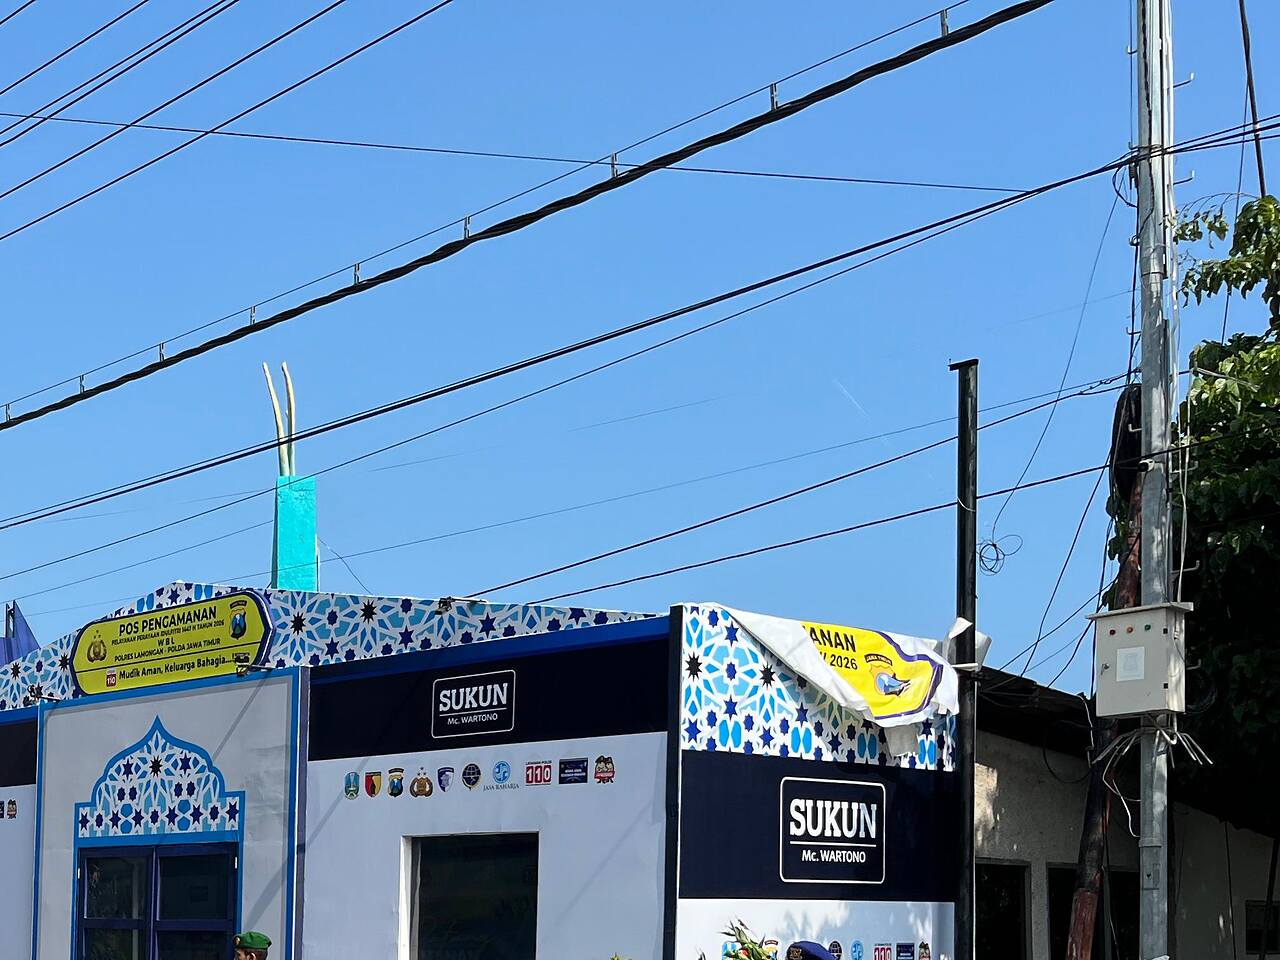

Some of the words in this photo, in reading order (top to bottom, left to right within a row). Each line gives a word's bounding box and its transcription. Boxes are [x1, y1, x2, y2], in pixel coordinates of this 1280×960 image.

[119, 618, 139, 636] POS
[141, 606, 217, 633] PENGAMANAN
[114, 652, 133, 662] POLRES
[133, 648, 163, 659] LAMONGAN
[167, 643, 186, 653] POLDA
[186, 641, 202, 650] JAWA
[202, 637, 221, 647] TIMUR
[119, 666, 140, 680] Mudik
[141, 664, 163, 677] Aman,
[164, 660, 196, 674] Keluarga
[830, 654, 858, 670] 2026
[439, 682, 508, 712] SUKUN
[461, 713, 498, 724] WARTONO
[526, 767, 551, 782] 110
[789, 798, 877, 840] SUKUN
[801, 849, 819, 863] Mc.
[820, 850, 866, 863] WARTONO
